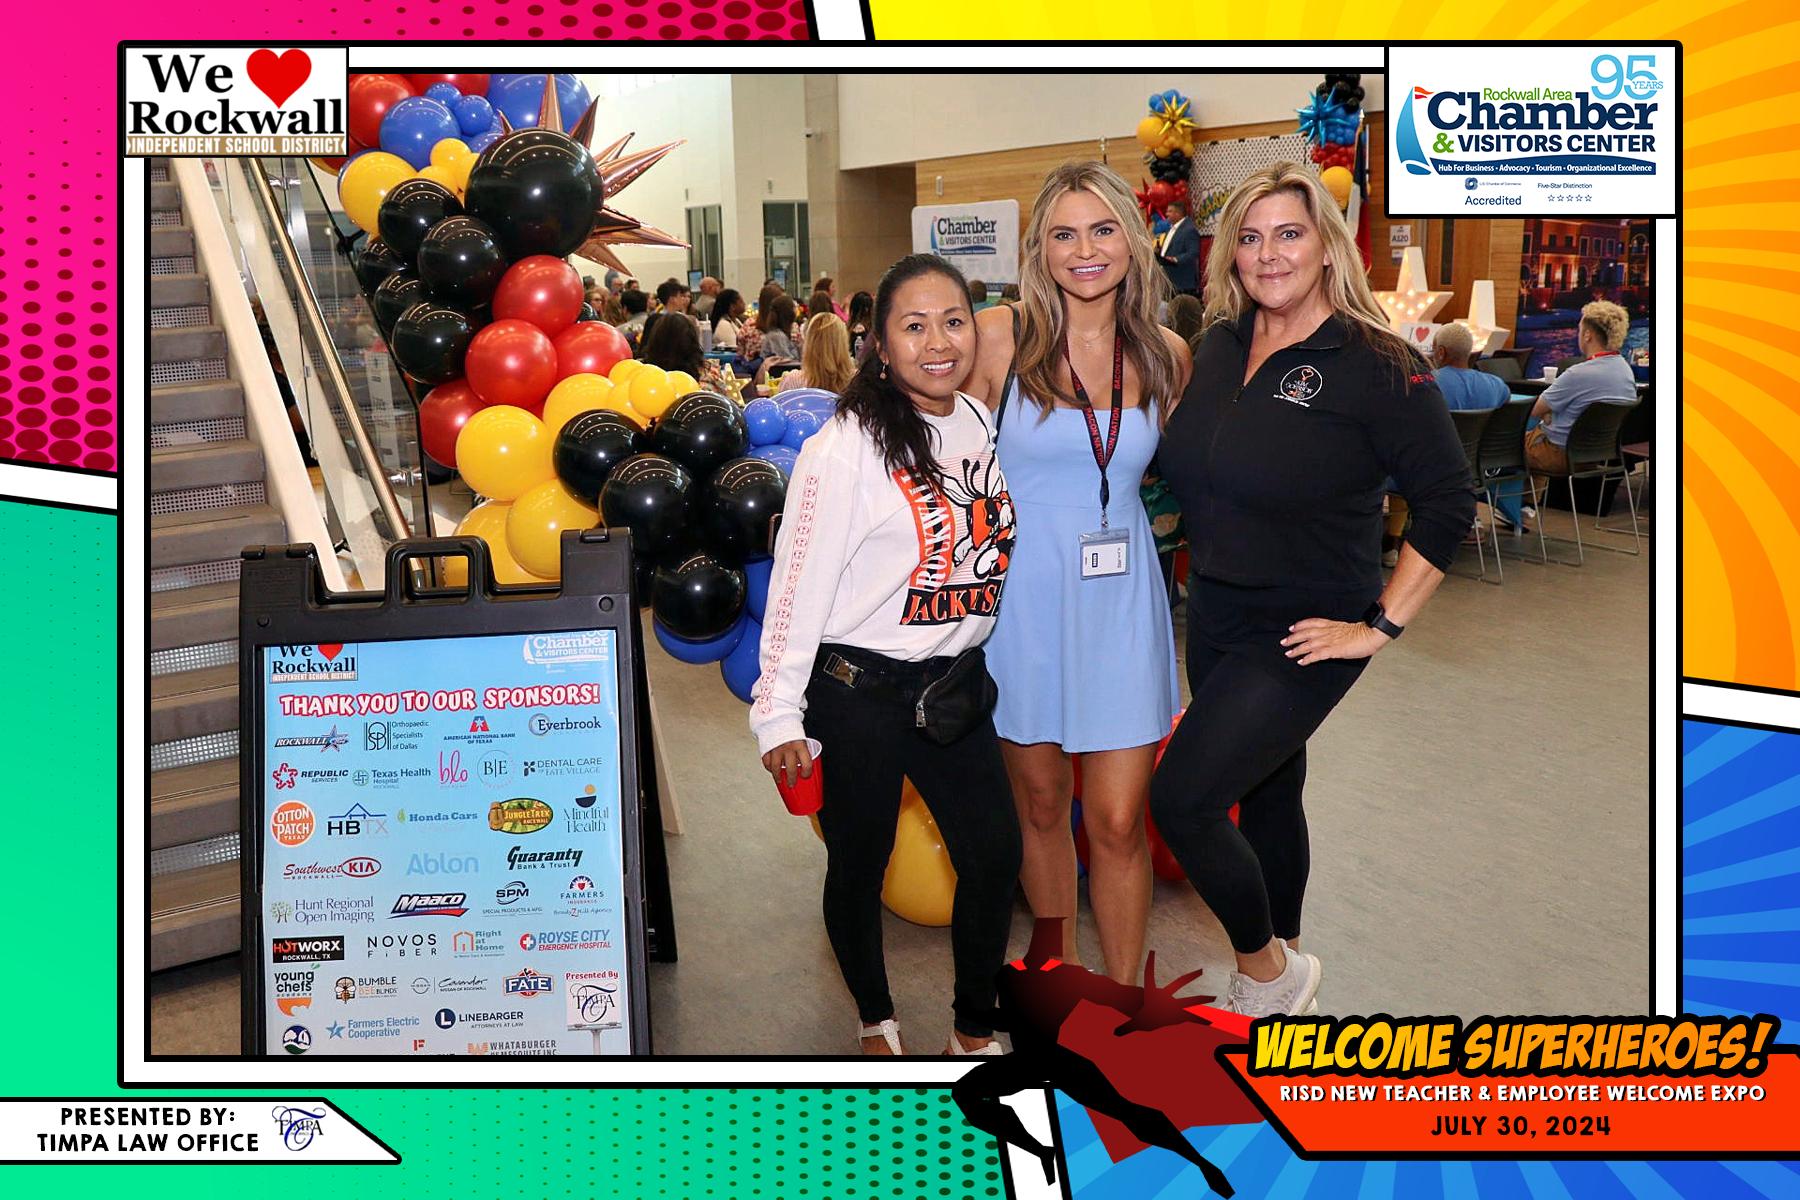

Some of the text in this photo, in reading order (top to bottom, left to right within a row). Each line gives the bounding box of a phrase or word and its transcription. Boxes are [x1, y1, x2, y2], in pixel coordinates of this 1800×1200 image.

[937, 216, 997, 235] Chamber
[945, 235, 972, 245] VISITORS
[972, 234, 997, 245] CENTER
[1108, 406, 1121, 438] NATION
[533, 634, 608, 650] Chamber
[279, 645, 313, 658] We
[272, 657, 356, 674] Rockwall
[279, 683, 601, 717] THANK YOU TO OUR SPONSORS!
[391, 720, 430, 728] Orthopaedic
[537, 716, 602, 732] Everbrook
[392, 731, 423, 739] Specialists
[276, 737, 328, 746] ROCKWALL
[537, 757, 603, 768] DENTAL CARE
[300, 769, 349, 779] REPUBLIC
[373, 768, 431, 779] Texas Health
[566, 765, 600, 775] VILLAGE
[373, 777, 399, 785] Hospital
[409, 811, 478, 822] Honda Cars
[563, 806, 609, 821] Mindful
[277, 823, 310, 841] PATCH
[566, 819, 606, 833] Health
[406, 851, 479, 877] Ablon
[507, 846, 583, 870] Guaranty
[283, 861, 375, 876] Southwest KIA
[549, 861, 571, 869] Trust
[496, 888, 529, 898] SPM
[560, 891, 605, 899] FARMERS
[295, 896, 375, 912] Hunt Regional
[393, 894, 465, 912] Maaco
[295, 909, 375, 925] Open Imaging
[475, 930, 502, 939] Right
[538, 929, 611, 944] ROYSE CITY
[273, 939, 341, 954] HOTWORX
[367, 934, 437, 948] NOVOS
[475, 943, 505, 951] Home
[538, 941, 612, 951] EMERGENCY HOSPITAL
[282, 953, 321, 961] ROCKWALL,
[274, 971, 315, 983] young
[358, 976, 397, 986] BUMBLE
[565, 970, 619, 980] Presented By
[276, 980, 312, 993] chefs
[376, 987, 398, 995] BLINDS
[508, 978, 549, 992] FATE
[459, 1010, 524, 1023] LINEBARGER
[348, 1016, 420, 1030] Farmers Electric
[348, 1028, 401, 1040] Cooperative
[490, 1040, 557, 1051] WHATABURGER
